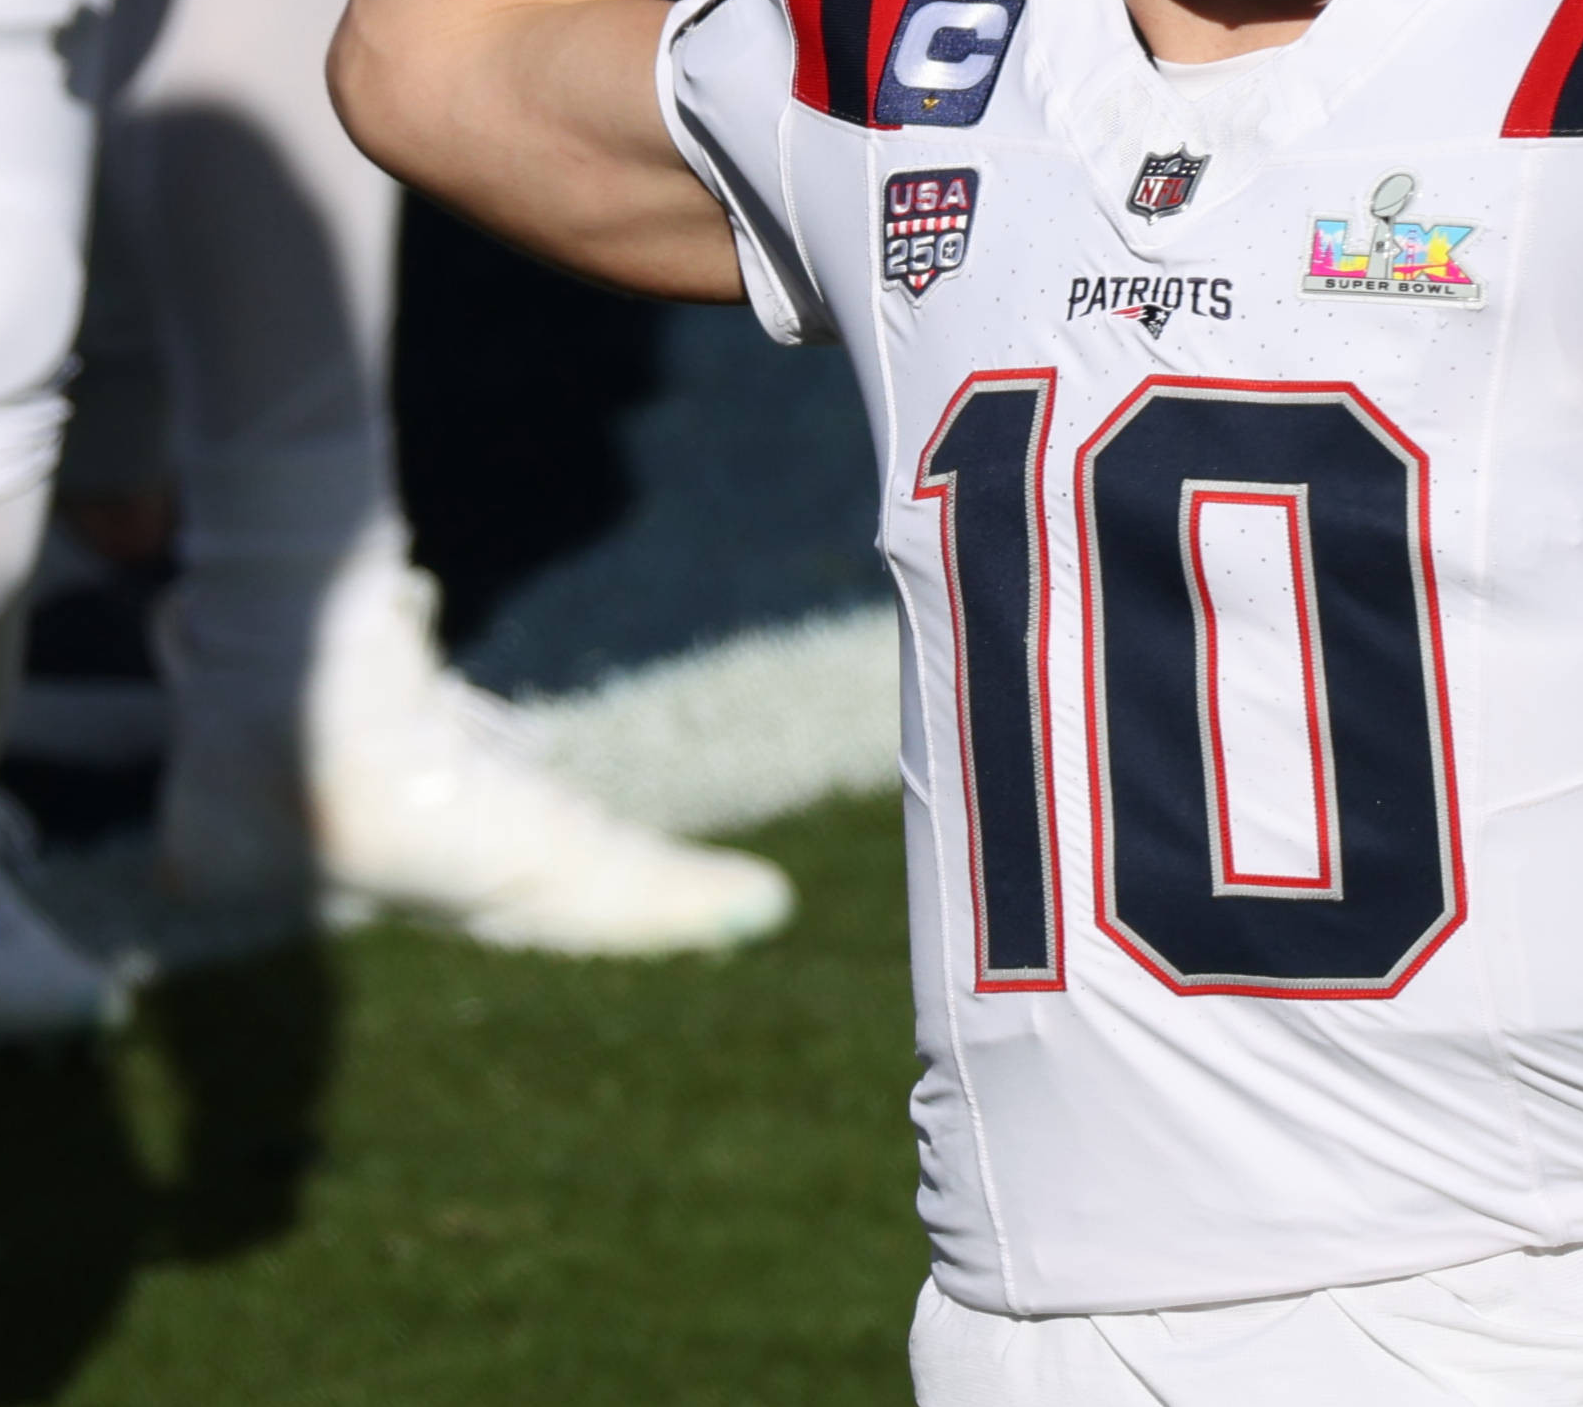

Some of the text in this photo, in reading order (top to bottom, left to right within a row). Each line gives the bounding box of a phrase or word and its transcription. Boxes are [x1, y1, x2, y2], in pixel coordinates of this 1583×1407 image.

[893, 0, 1009, 91] C
[889, 178, 970, 216] USA
[1135, 176, 1187, 207] NFL
[885, 231, 966, 275] 250
[1067, 275, 1233, 321] PATRIOTS
[1324, 278, 1457, 296] SUPER BOWL
[911, 366, 1468, 1000] 10
